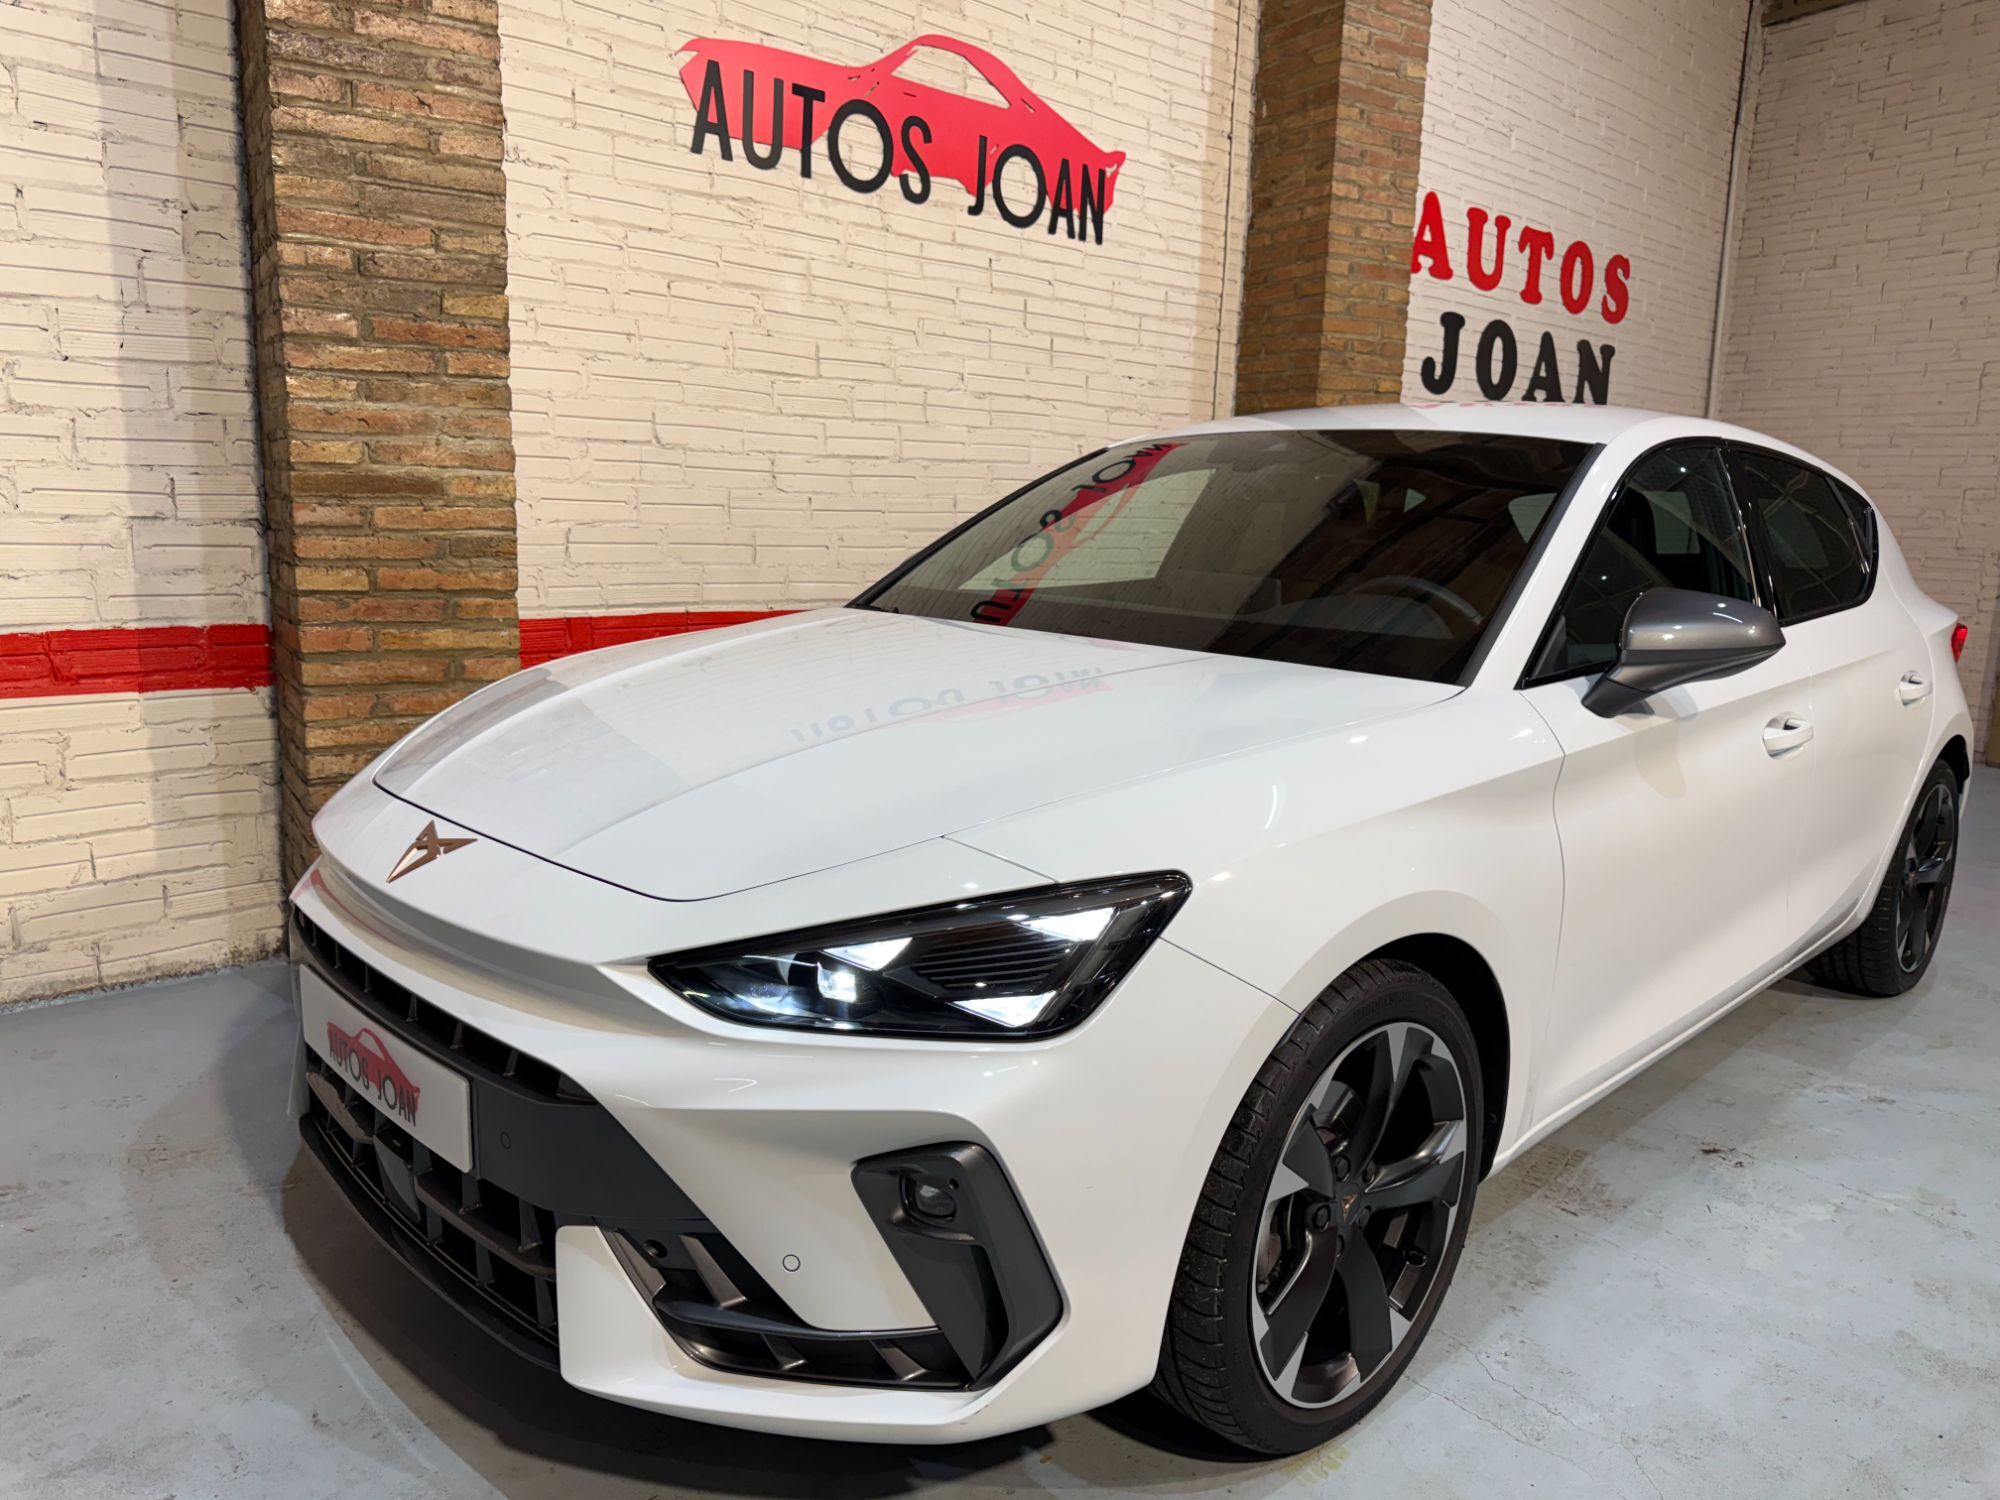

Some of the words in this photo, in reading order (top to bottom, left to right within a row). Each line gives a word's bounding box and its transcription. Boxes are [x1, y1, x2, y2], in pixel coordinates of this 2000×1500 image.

[690, 59, 932, 204] AUTOS
[967, 135, 1106, 245] JOAN
[1411, 191, 1631, 324] AUTOS
[1421, 311, 1615, 405] JOAN
[329, 1035, 370, 1090] AUTOS
[377, 1069, 417, 1127] JOAN
